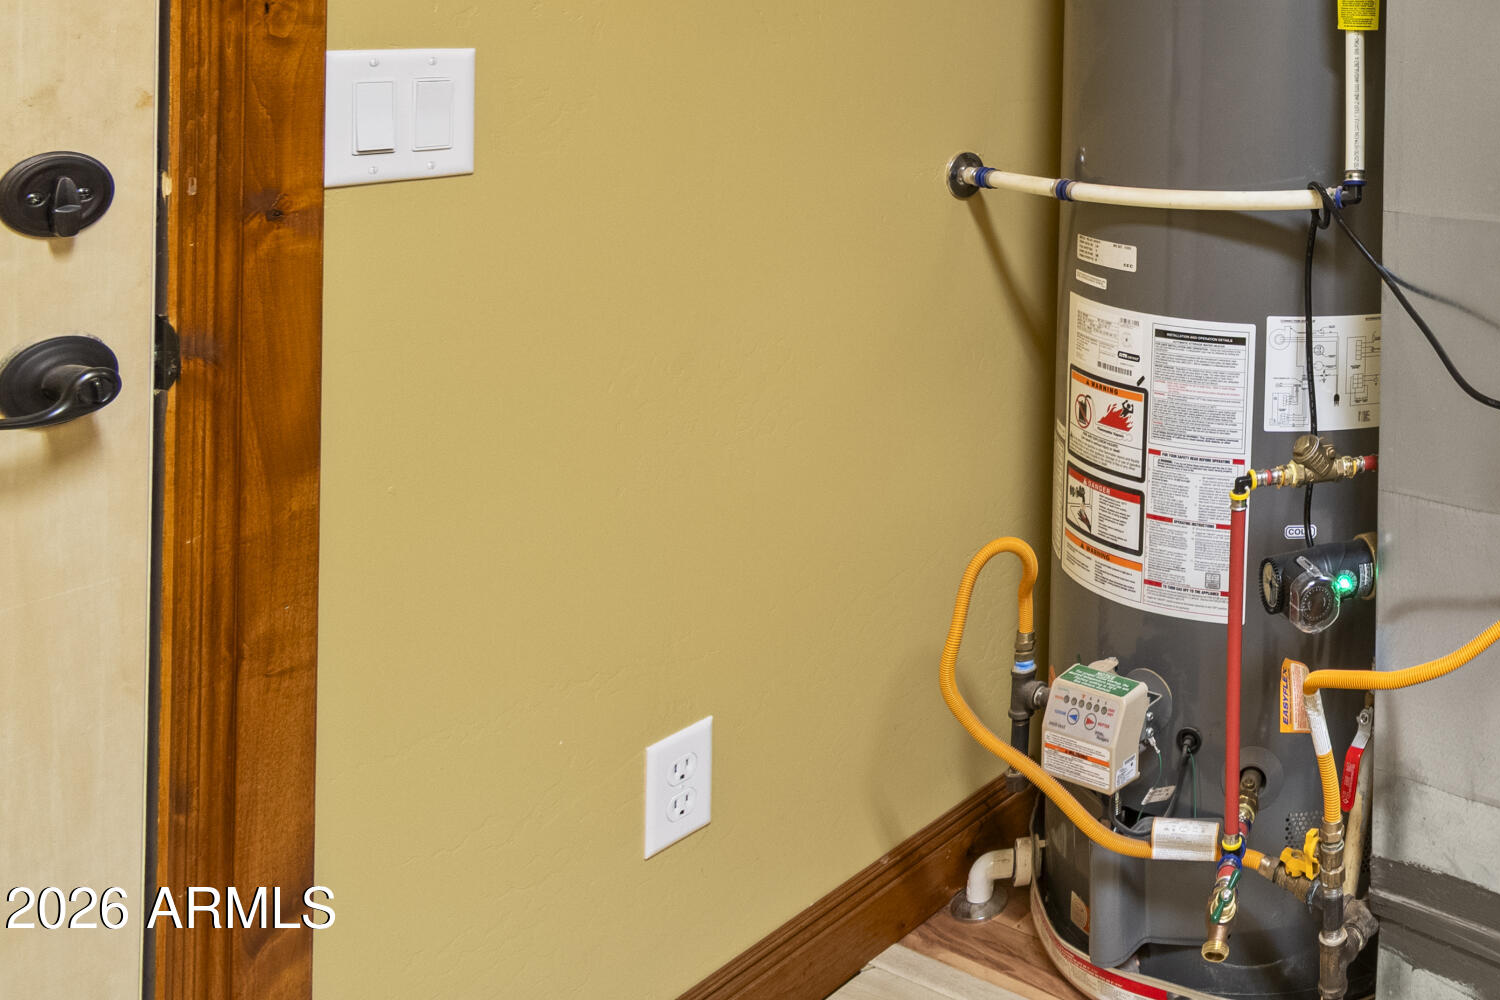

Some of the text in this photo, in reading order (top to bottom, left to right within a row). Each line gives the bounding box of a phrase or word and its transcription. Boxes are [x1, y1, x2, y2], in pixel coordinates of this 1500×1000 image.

[1091, 380, 1119, 396] WARNING
[1087, 481, 1111, 495] DANGER
[1288, 528, 1311, 536] COL
[1086, 544, 1110, 561] WARNING
